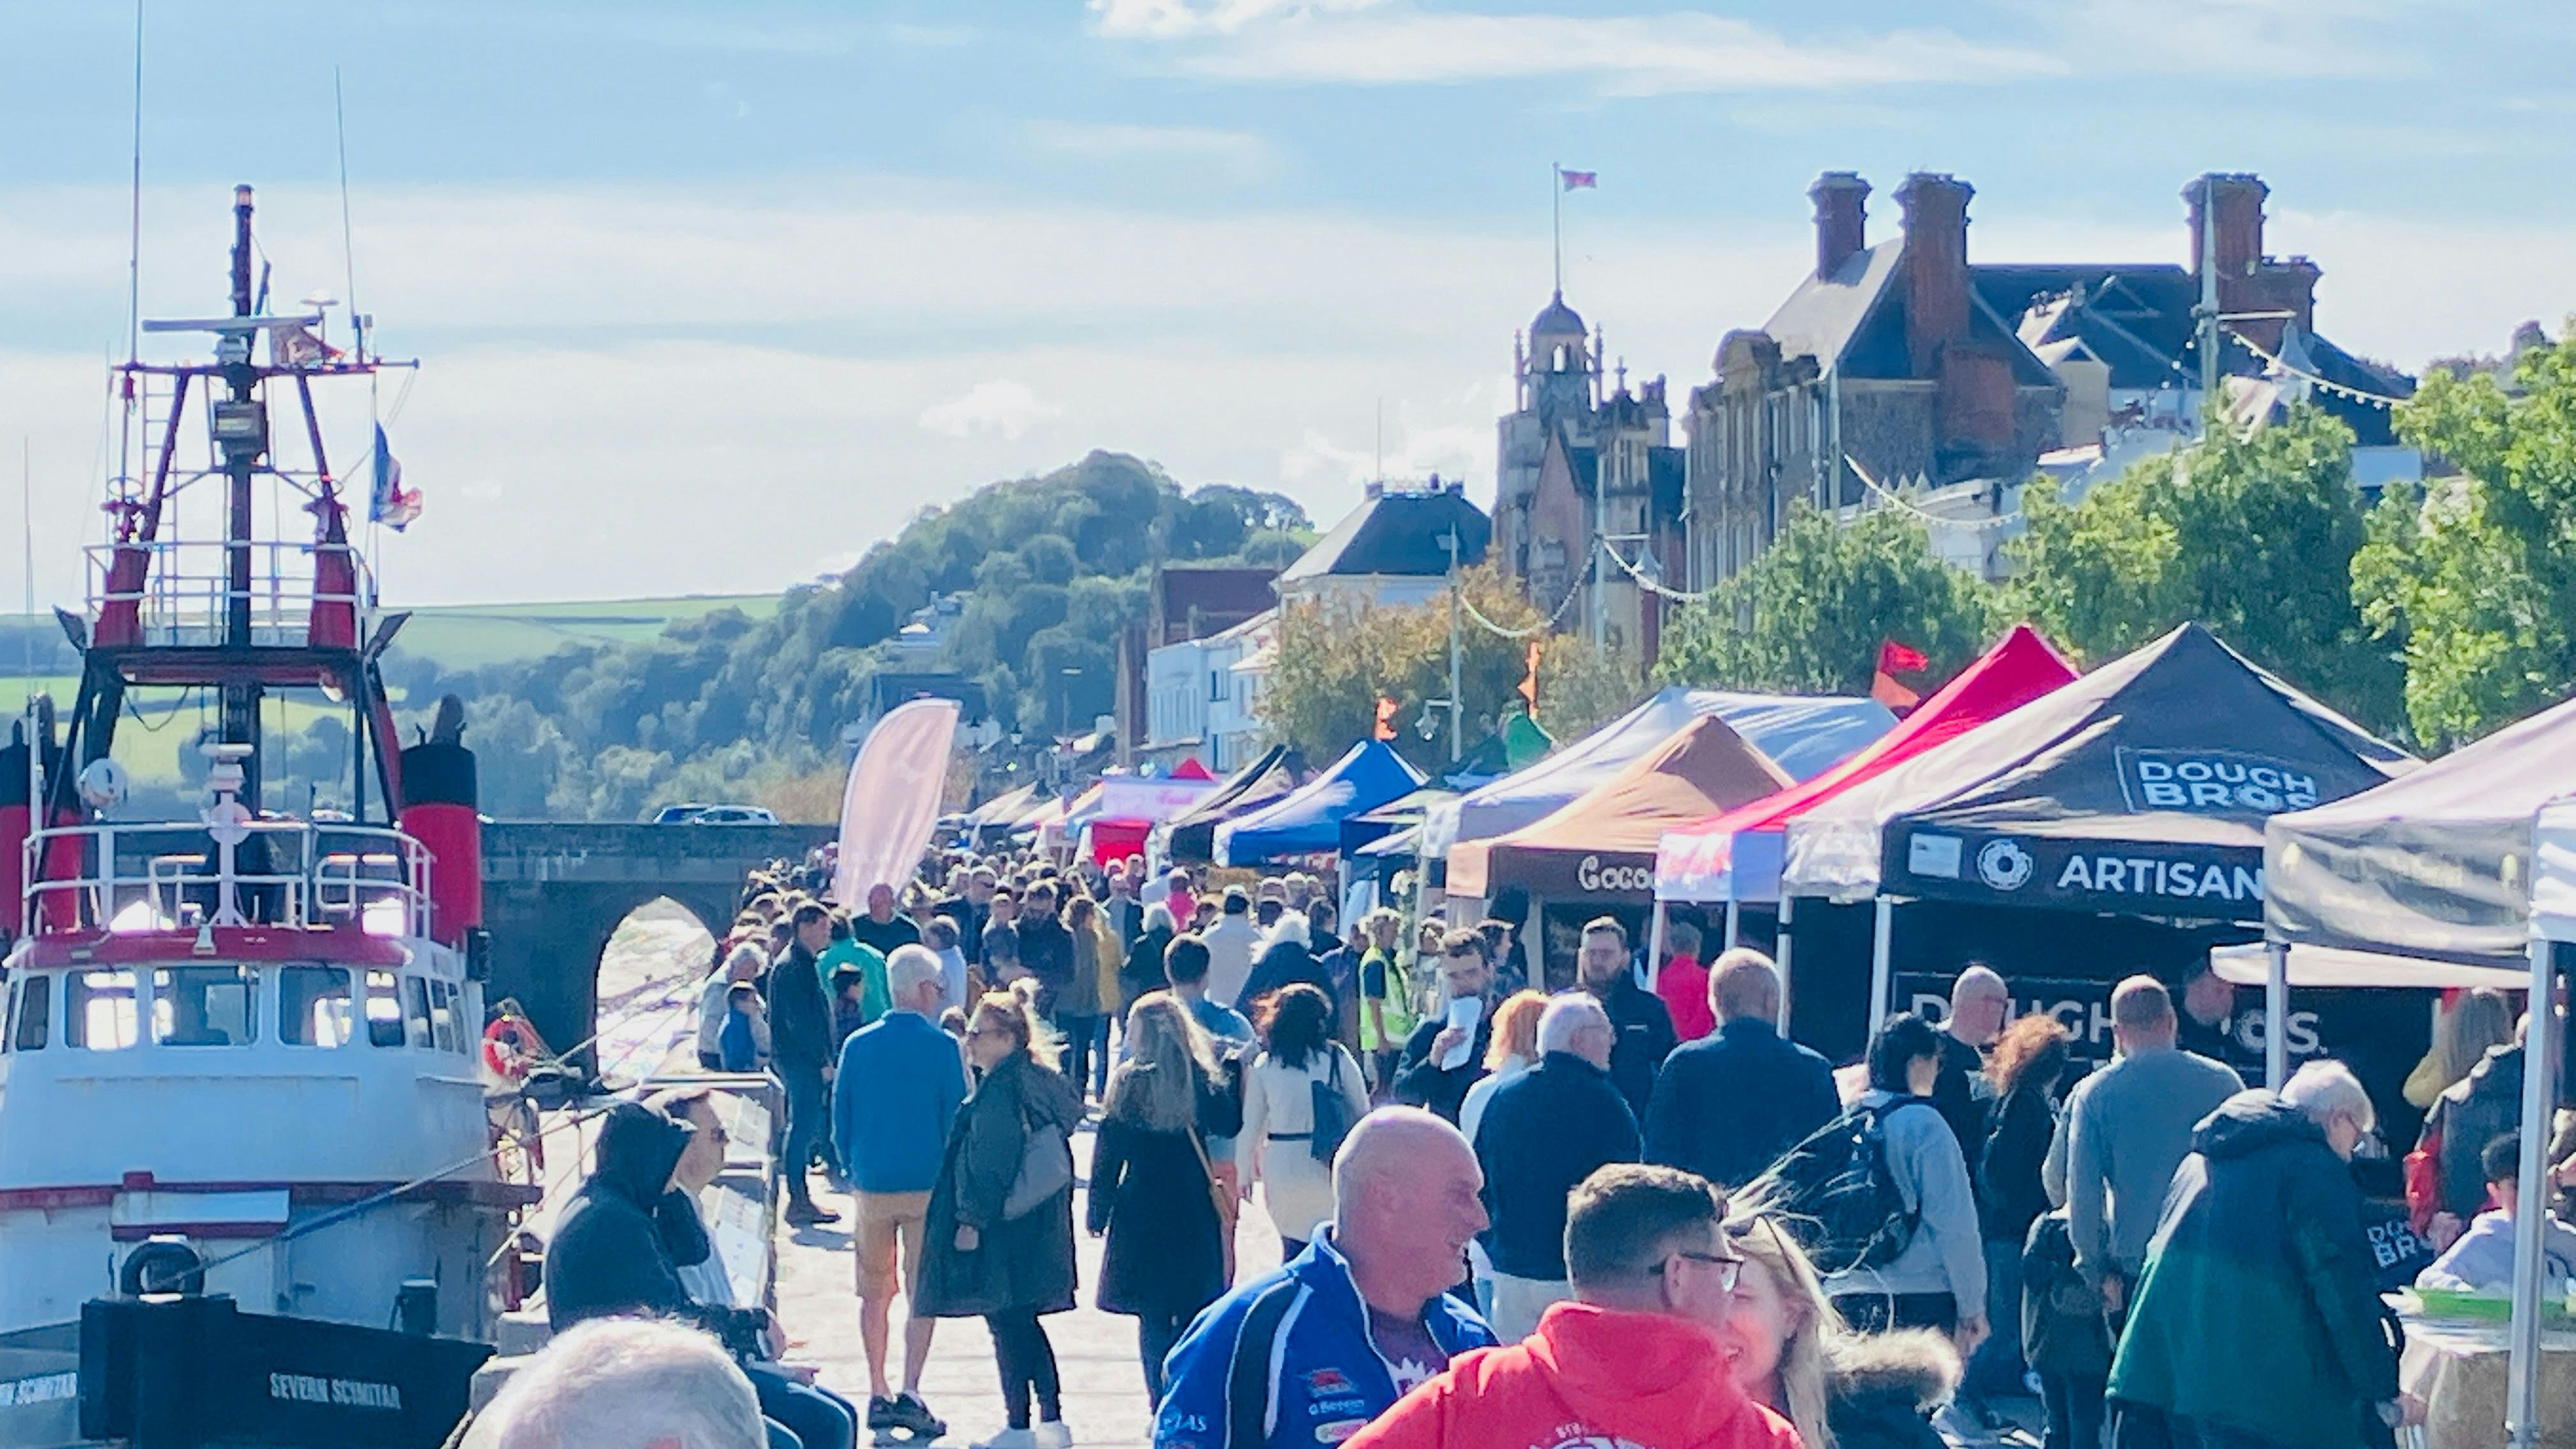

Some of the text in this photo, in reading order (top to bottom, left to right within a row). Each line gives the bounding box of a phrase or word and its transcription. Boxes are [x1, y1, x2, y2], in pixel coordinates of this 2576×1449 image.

[2139, 761, 2318, 795] DOUGH
[2142, 782, 2317, 811] BROS
[2056, 855, 2264, 901] ARTISAN
[270, 1372, 401, 1409] SEVERN SCIMITAR
